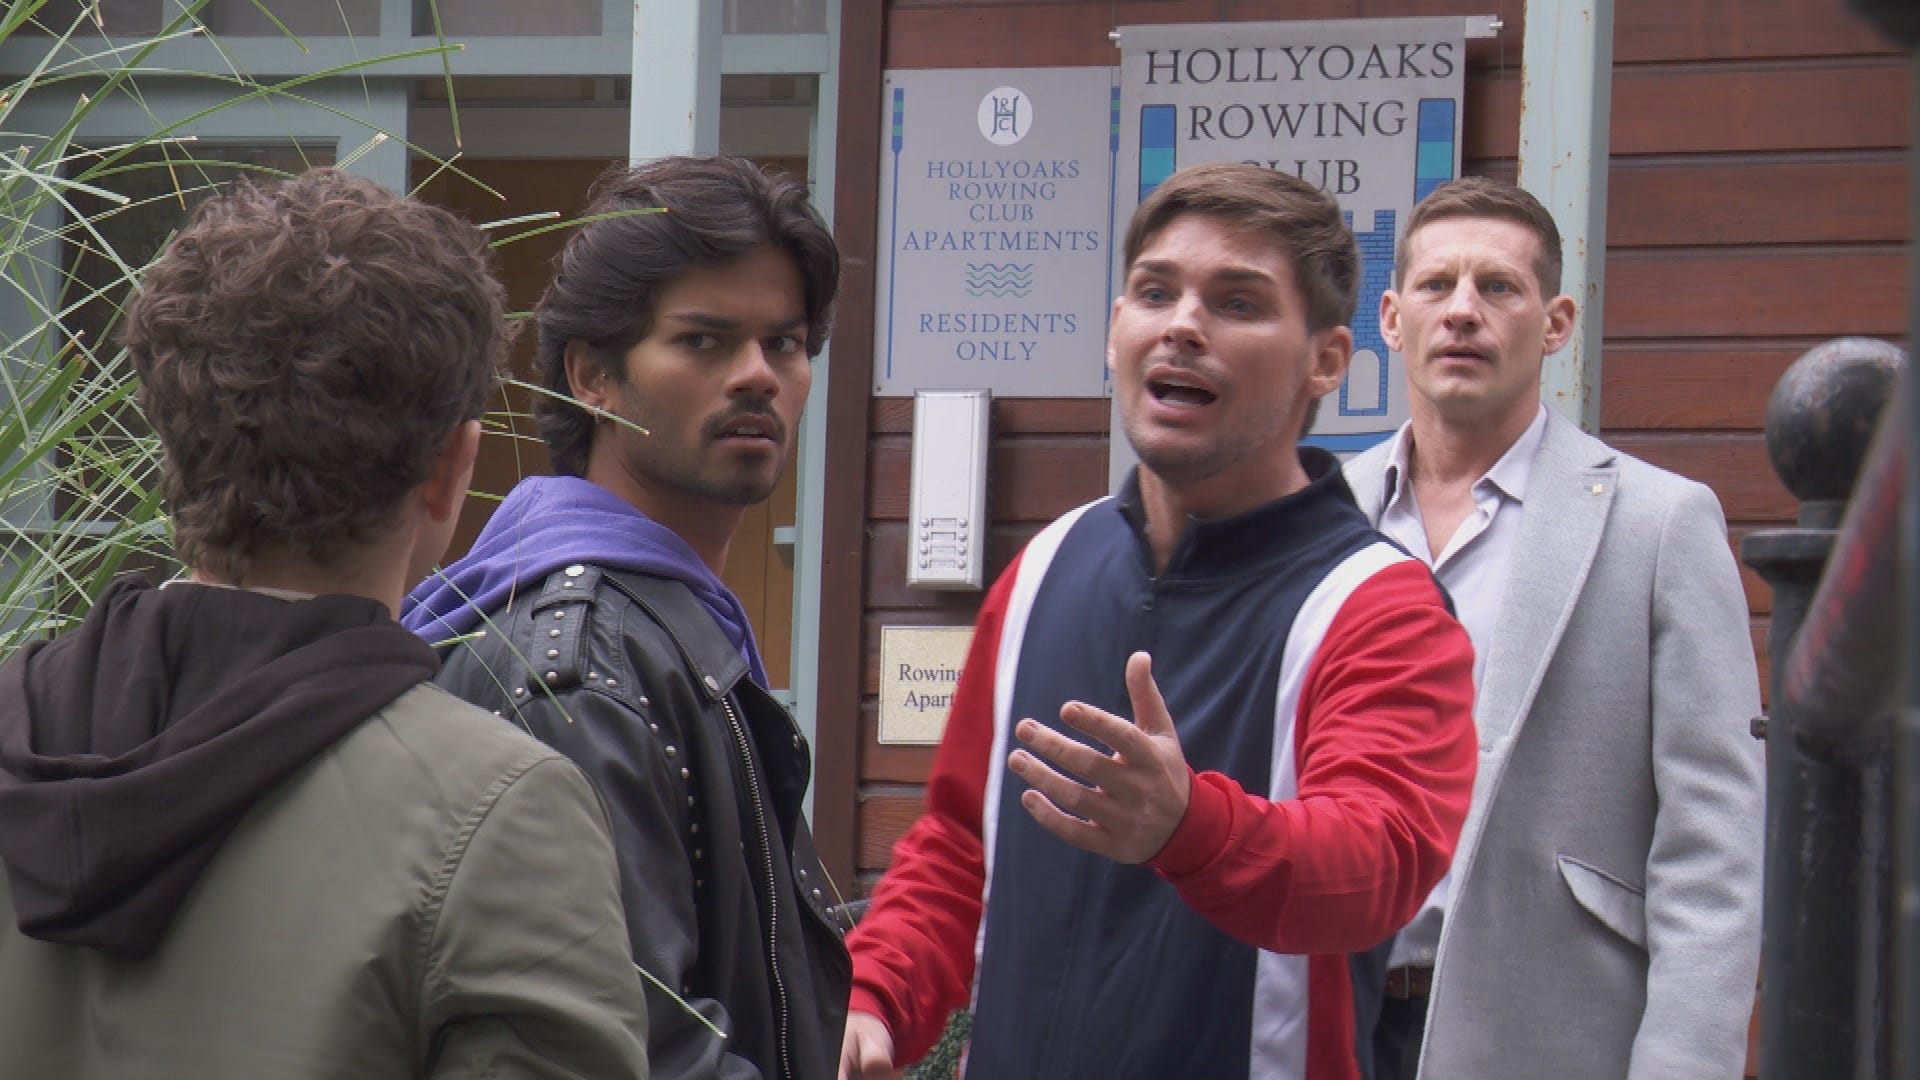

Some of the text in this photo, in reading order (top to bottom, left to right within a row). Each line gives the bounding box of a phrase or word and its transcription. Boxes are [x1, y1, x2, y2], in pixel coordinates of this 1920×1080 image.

[1145, 42, 1455, 84] HOLLYOAKS
[1188, 100, 1408, 141] ROWING
[927, 160, 1080, 179] HOLLYOAKS
[949, 182, 1056, 201] ROWING
[969, 204, 1034, 223] CLUB
[902, 231, 1100, 251] APARTMENTS
[919, 313, 1077, 334] RESIDENTS
[956, 341, 1038, 361] ONLY
